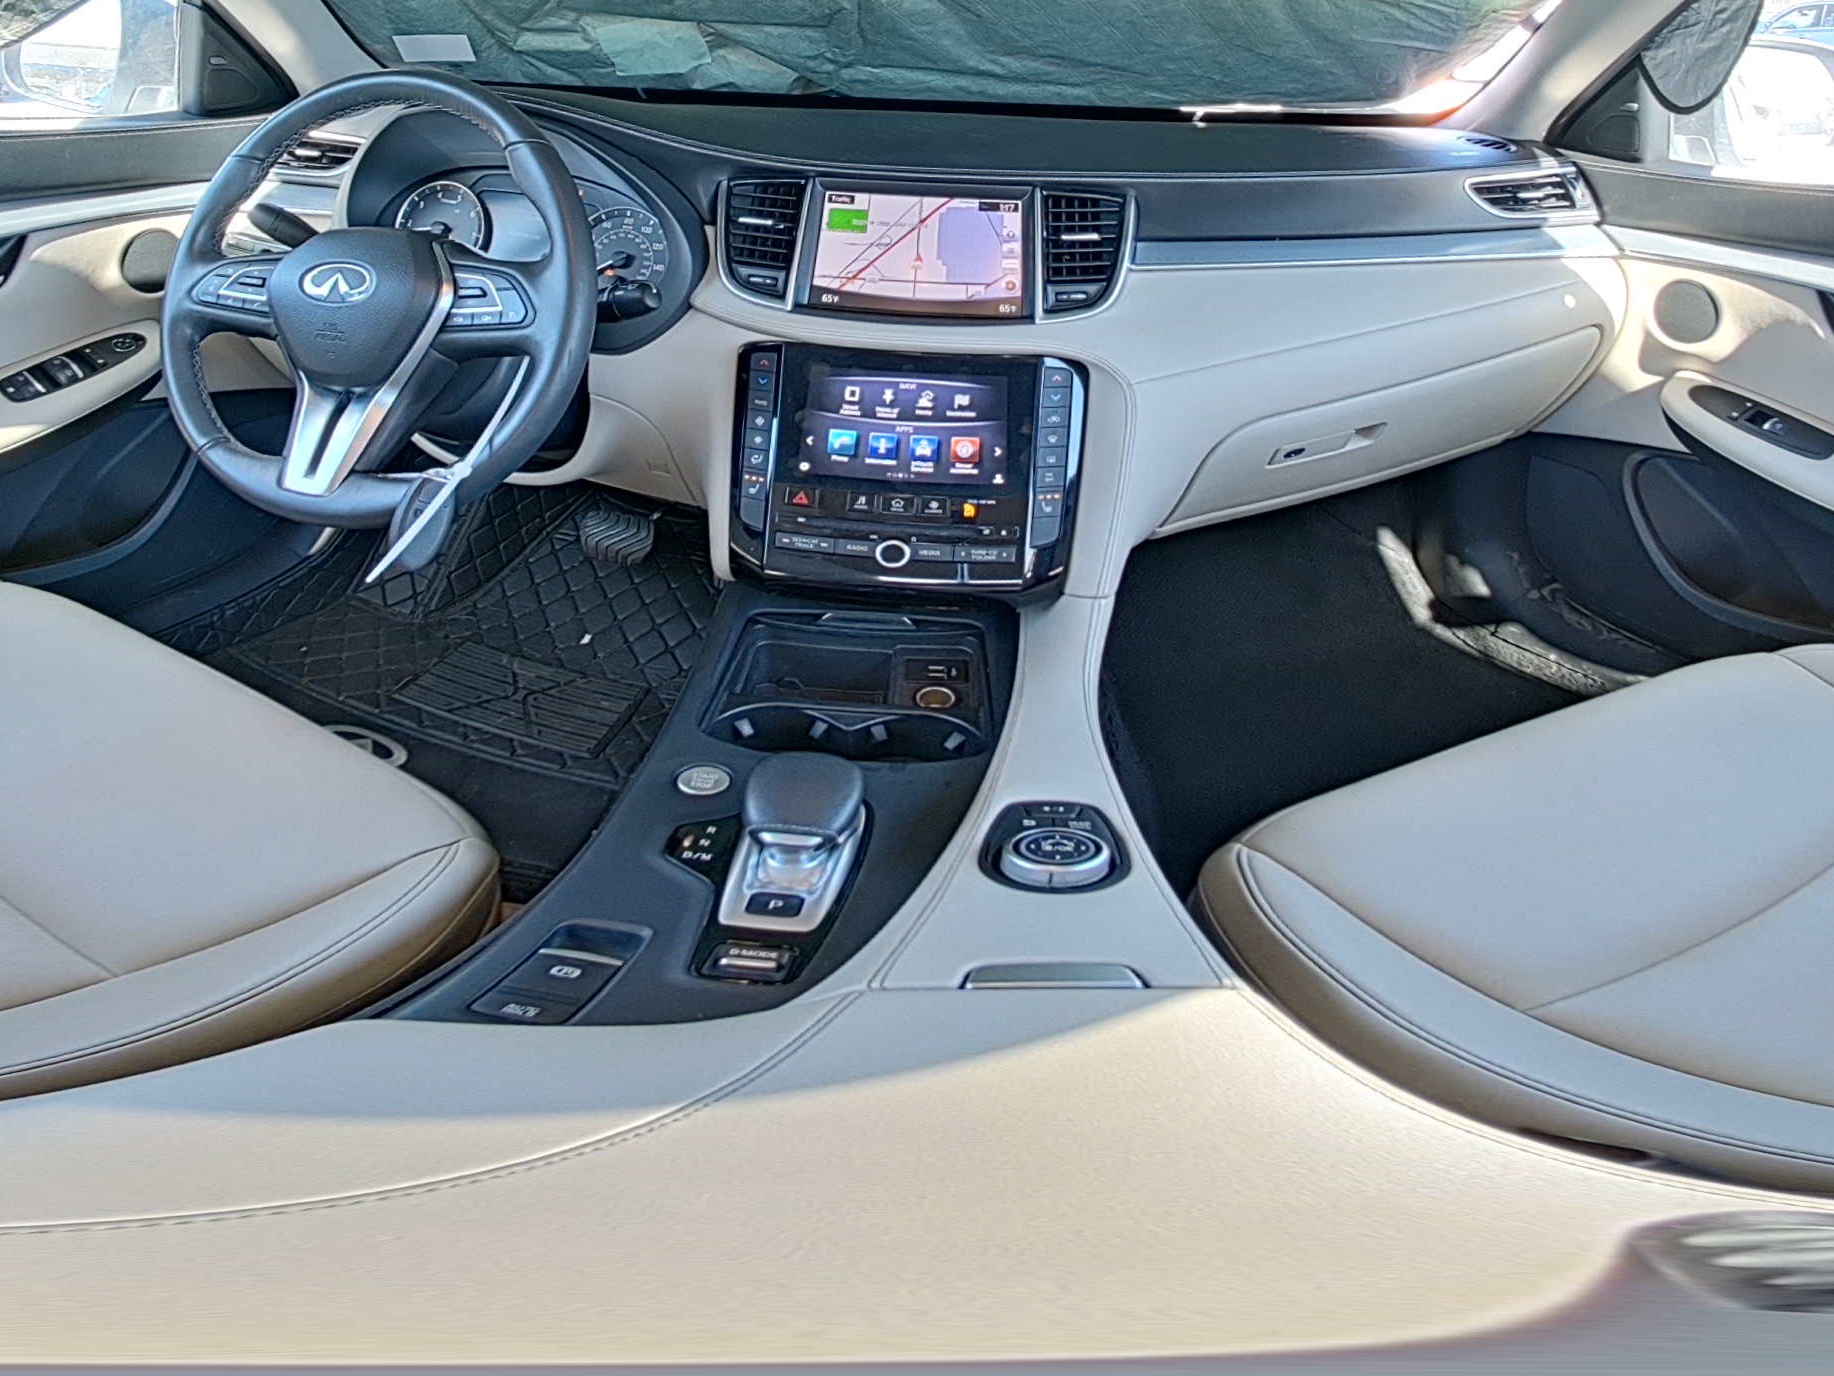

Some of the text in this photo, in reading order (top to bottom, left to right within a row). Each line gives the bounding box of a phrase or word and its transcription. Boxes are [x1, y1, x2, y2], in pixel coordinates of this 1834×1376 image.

[831, 195, 852, 203] Traffic
[865, 457, 897, 465] Information
[706, 826, 716, 834] R
[699, 839, 711, 847] N
[682, 851, 714, 860] D/M
[768, 899, 784, 909] P
